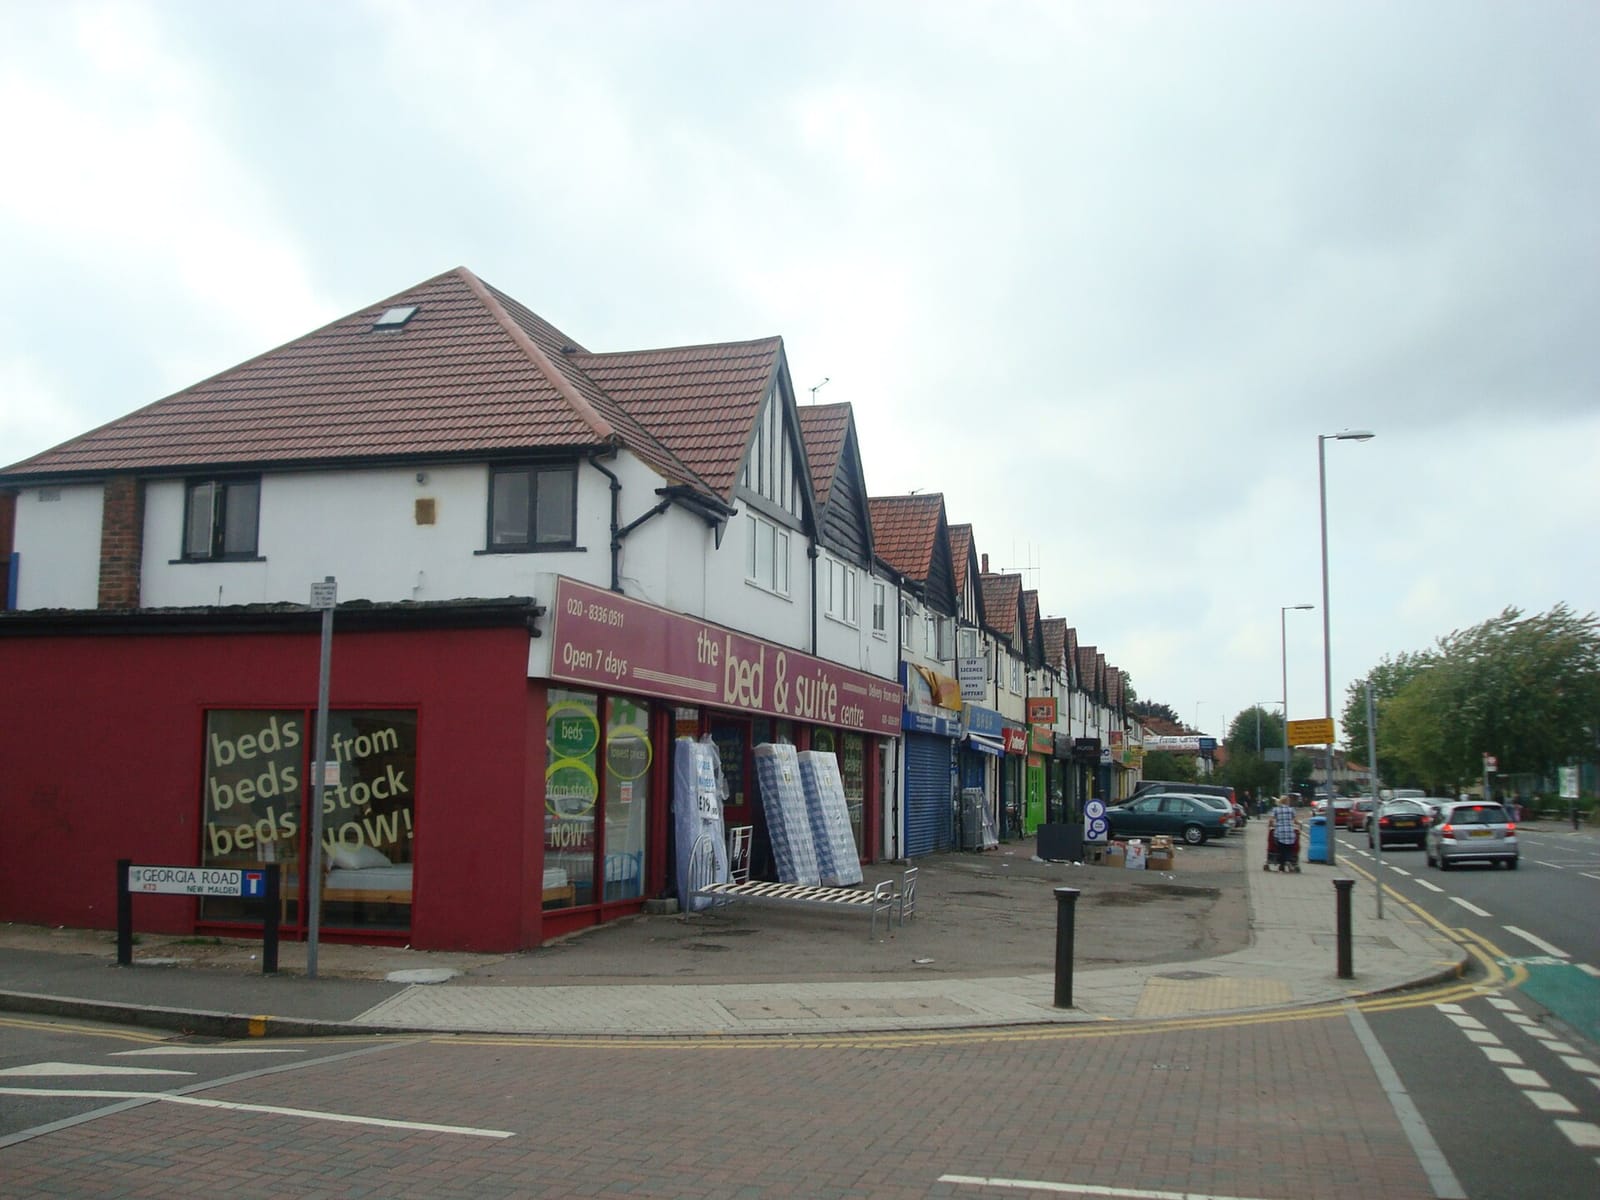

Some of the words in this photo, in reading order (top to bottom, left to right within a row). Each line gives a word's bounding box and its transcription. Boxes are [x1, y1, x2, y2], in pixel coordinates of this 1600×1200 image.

[567, 598, 583, 616] 020
[588, 604, 608, 623] 8336
[608, 610, 624, 628] 0511
[563, 642, 592, 671] Open
[595, 649, 603, 670] 7
[604, 651, 628, 680] days
[697, 628, 719, 666] the
[724, 635, 765, 709] bed
[773, 651, 789, 713] &
[795, 669, 838, 722] suite
[562, 720, 584, 740] beds
[840, 703, 864, 727] centre
[211, 716, 299, 767] beds
[331, 727, 399, 763] from
[210, 761, 299, 811] beds
[322, 764, 409, 814] stock
[545, 777, 570, 798] from
[208, 806, 297, 857] beds
[551, 823, 587, 848] NOW!
[142, 869, 196, 884] GEORGIA
[202, 871, 239, 885] ROAD
[208, 886, 239, 894] MALDEN
